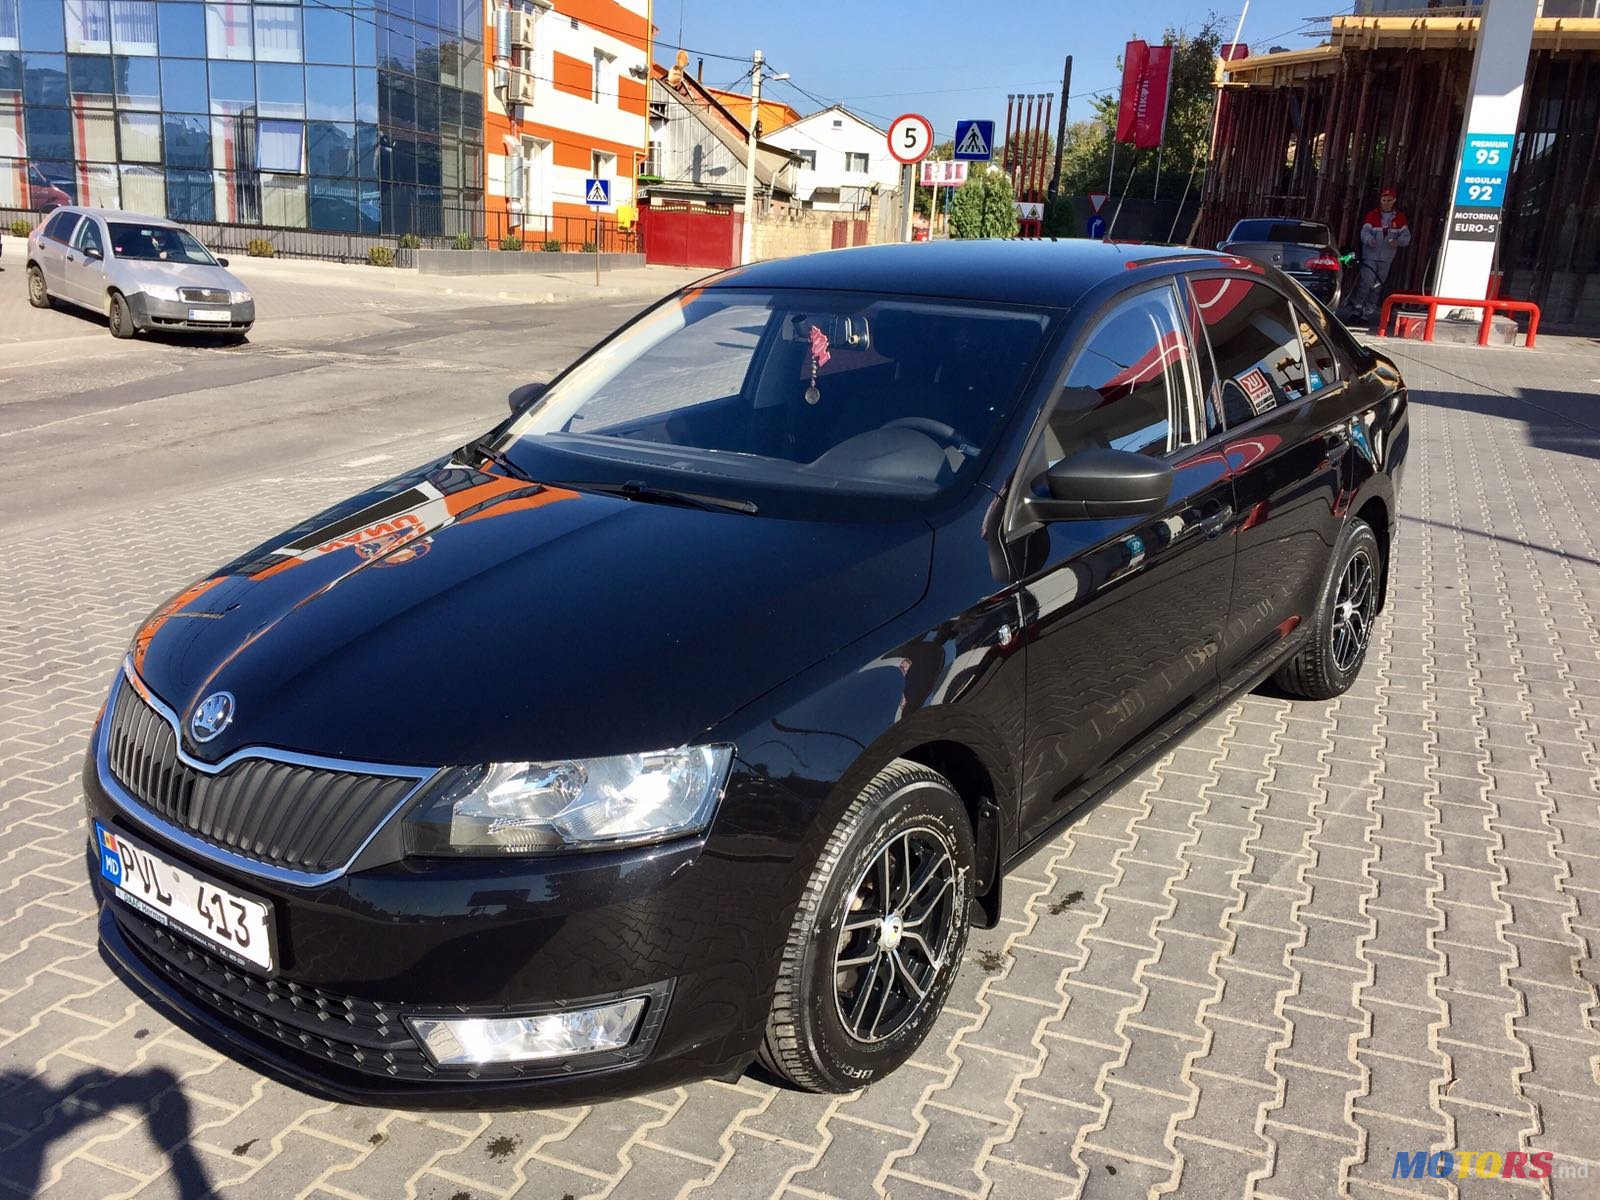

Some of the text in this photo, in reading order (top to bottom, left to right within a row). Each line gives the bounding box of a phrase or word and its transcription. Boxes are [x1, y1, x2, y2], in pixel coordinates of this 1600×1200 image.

[903, 127, 917, 149] 5
[1471, 140, 1509, 149] PREMIUM
[1475, 149, 1500, 165] 95
[1465, 177, 1503, 185] REGULAR
[1468, 185, 1494, 201] 92
[1454, 211, 1499, 221] MOTORINA
[1455, 223, 1495, 234] EURO-5
[105, 854, 119, 876] MD
[117, 841, 172, 907] PVL
[197, 886, 251, 949] 413
